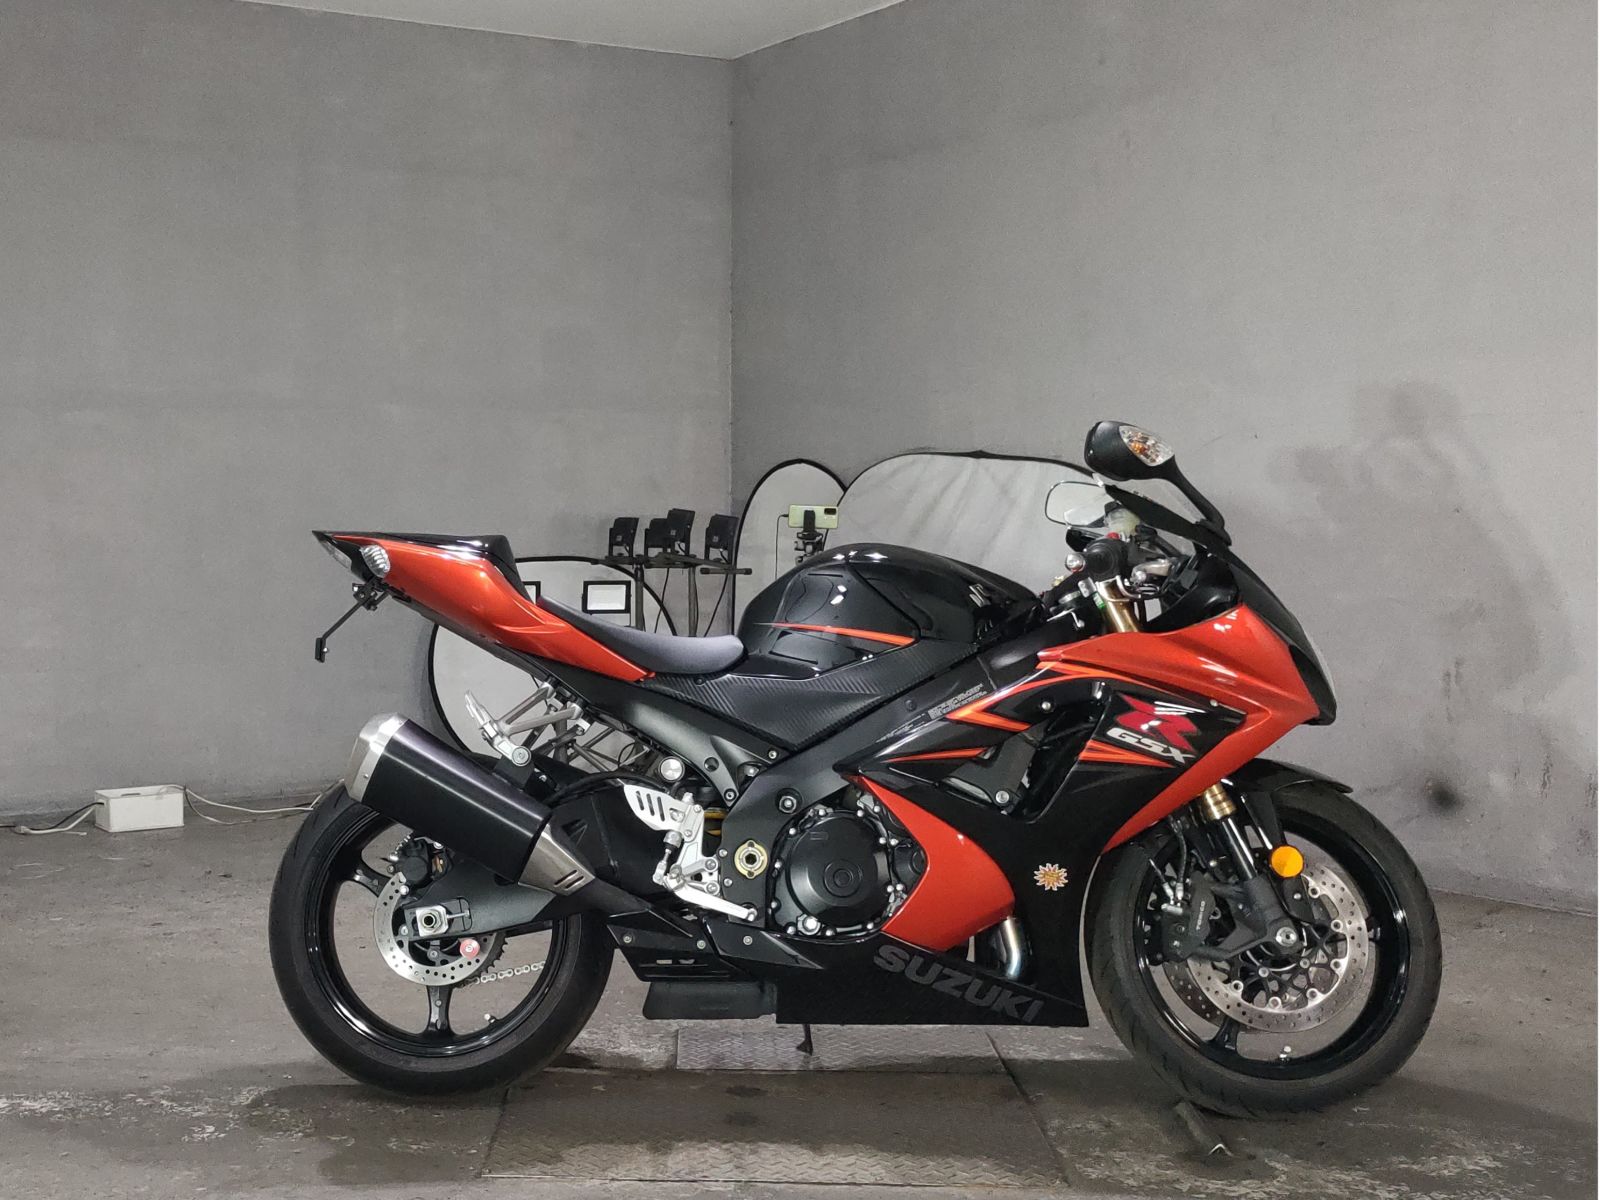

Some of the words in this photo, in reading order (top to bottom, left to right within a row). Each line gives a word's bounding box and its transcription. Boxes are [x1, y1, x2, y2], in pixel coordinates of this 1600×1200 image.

[1106, 727, 1196, 764] GSX
[1115, 691, 1198, 754] R
[873, 944, 1045, 1023] SUZUKI
